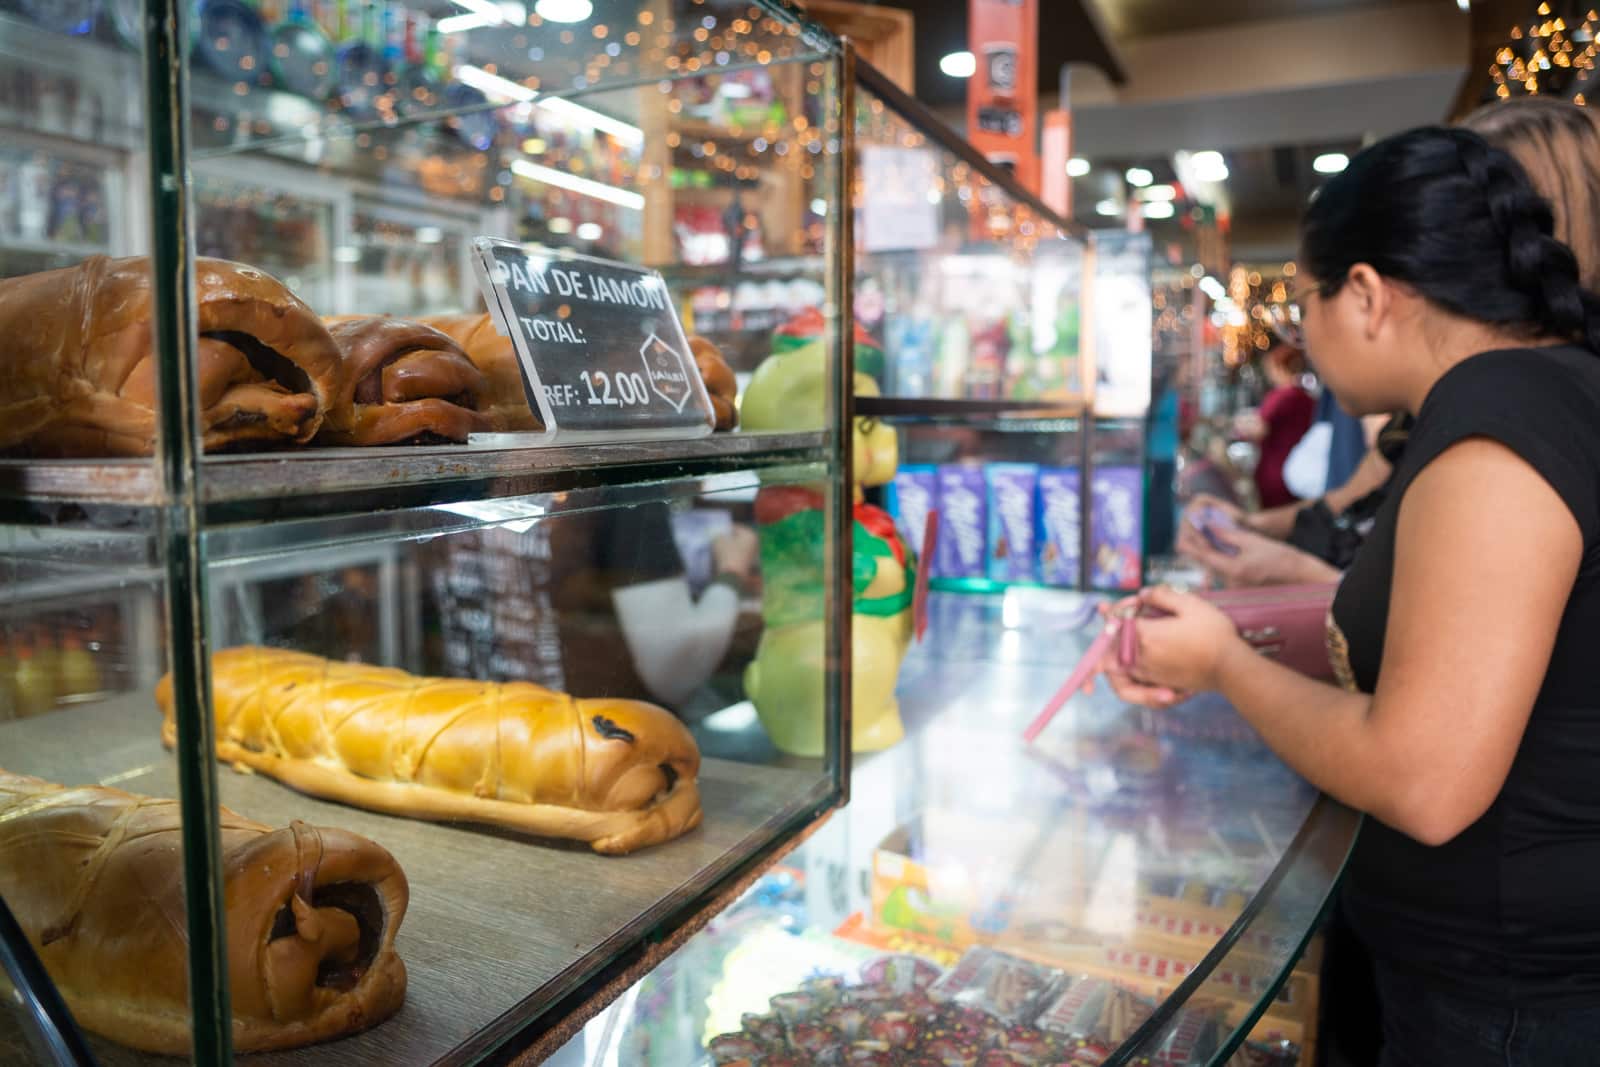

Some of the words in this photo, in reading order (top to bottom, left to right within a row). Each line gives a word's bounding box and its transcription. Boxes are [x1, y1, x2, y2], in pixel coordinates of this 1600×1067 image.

[495, 260, 549, 295] PAN
[551, 269, 587, 299] DE
[520, 317, 587, 344] TOTAL:
[543, 385, 580, 406] REF:
[580, 370, 649, 408] 12,00
